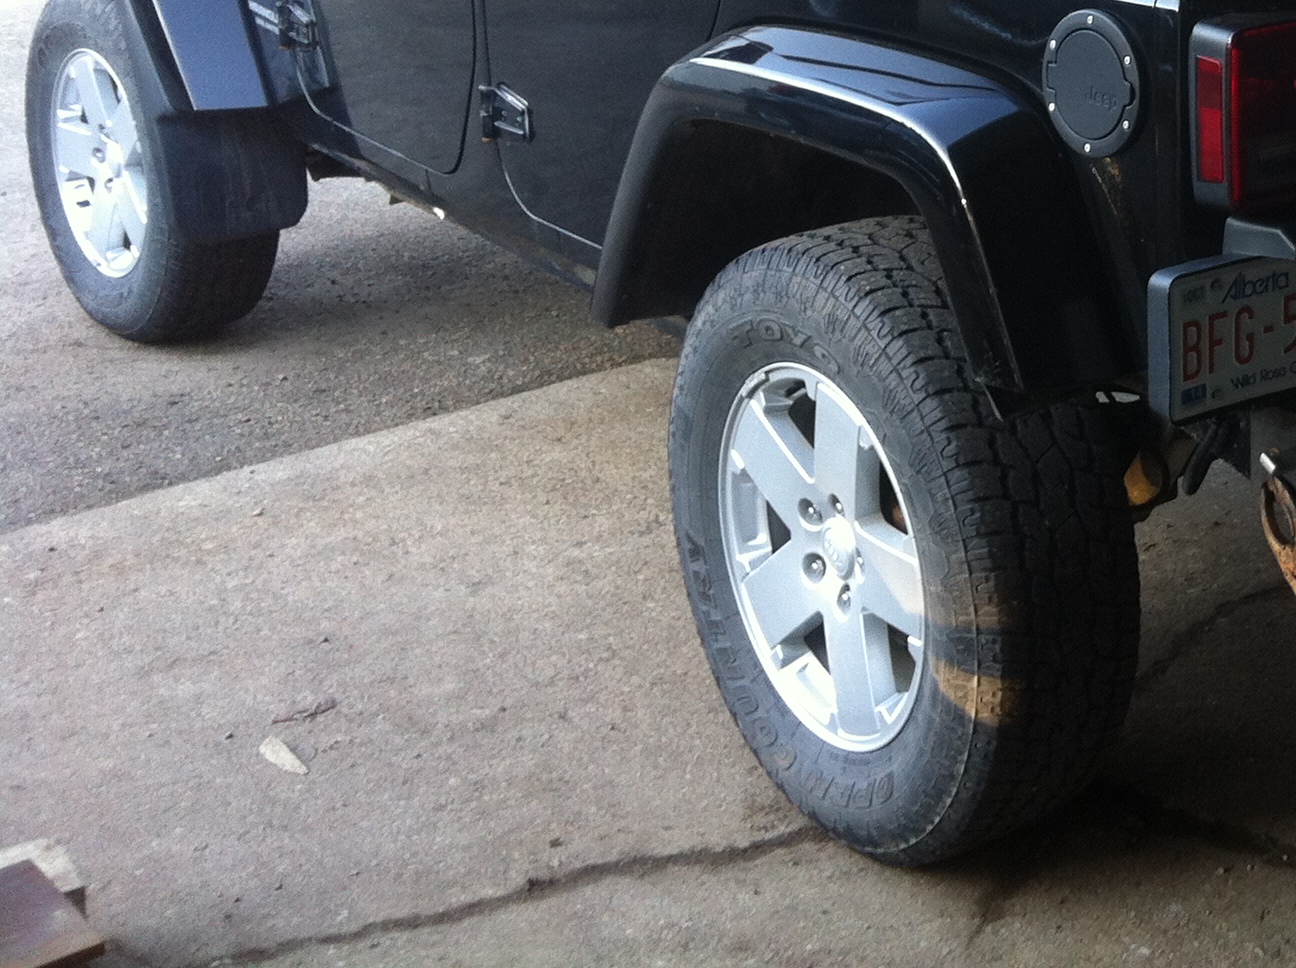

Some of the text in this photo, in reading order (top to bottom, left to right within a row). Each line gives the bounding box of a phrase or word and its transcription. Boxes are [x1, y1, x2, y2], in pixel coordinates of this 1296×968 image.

[1084, 85, 1117, 112] Jeep
[1222, 270, 1290, 304] Alberta
[1230, 371, 1257, 390] Wild
[1260, 365, 1288, 383] Rose
